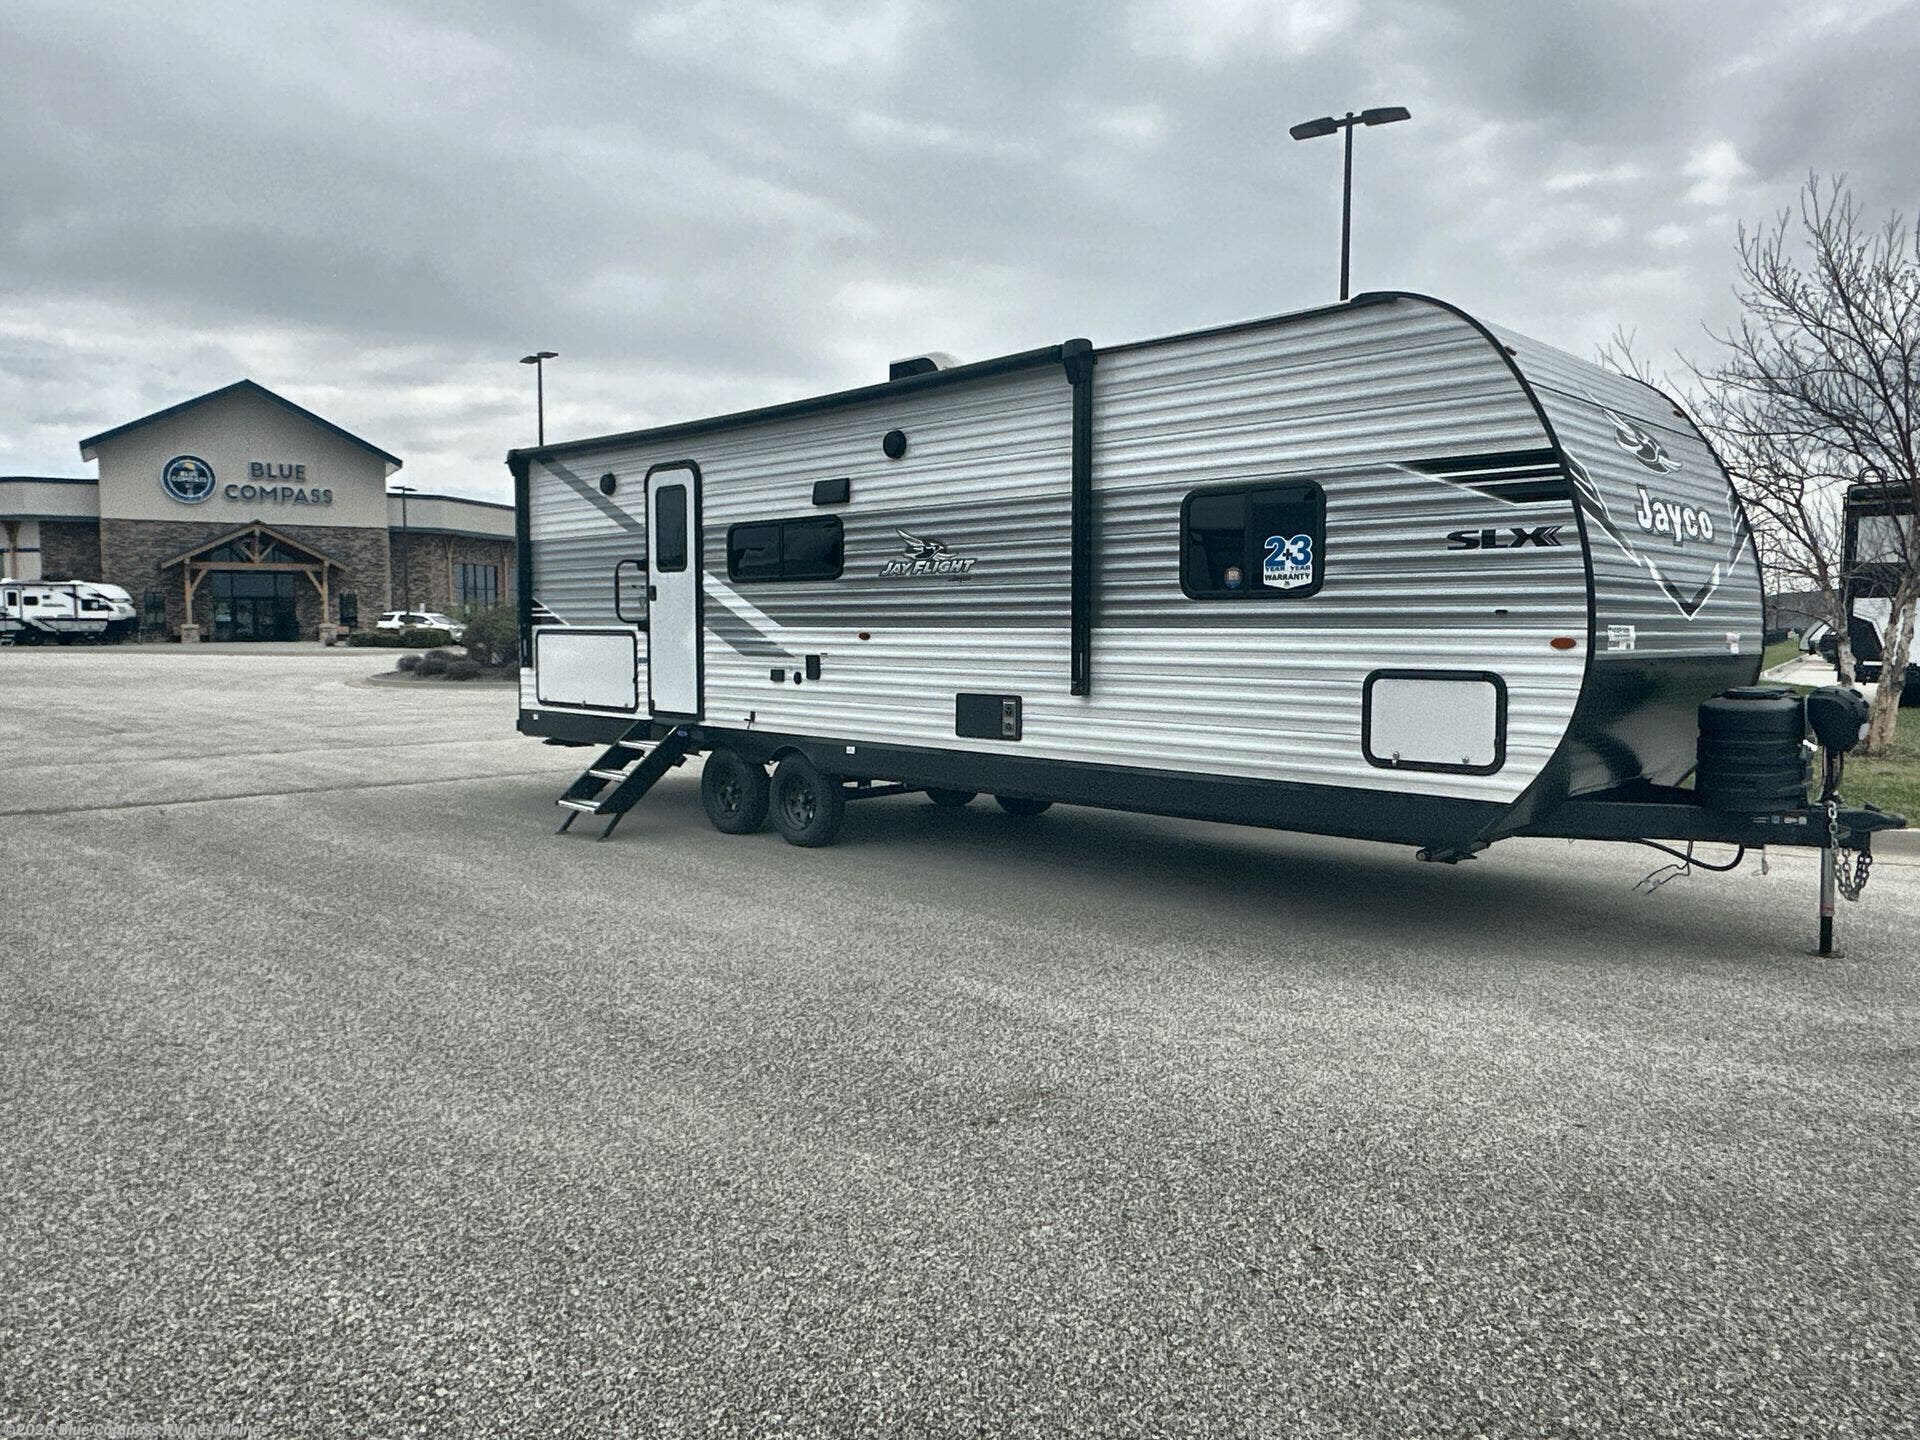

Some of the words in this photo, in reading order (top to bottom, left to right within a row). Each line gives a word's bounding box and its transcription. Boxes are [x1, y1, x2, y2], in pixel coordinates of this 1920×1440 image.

[249, 461, 306, 480] BLUE
[223, 484, 333, 504] COMPASS
[1635, 483, 1715, 547] Jayco
[1446, 526, 1562, 551] SLX
[880, 561, 912, 576] JAY
[912, 559, 977, 575] FLIGHT
[1264, 572, 1311, 581] WARRANTY
